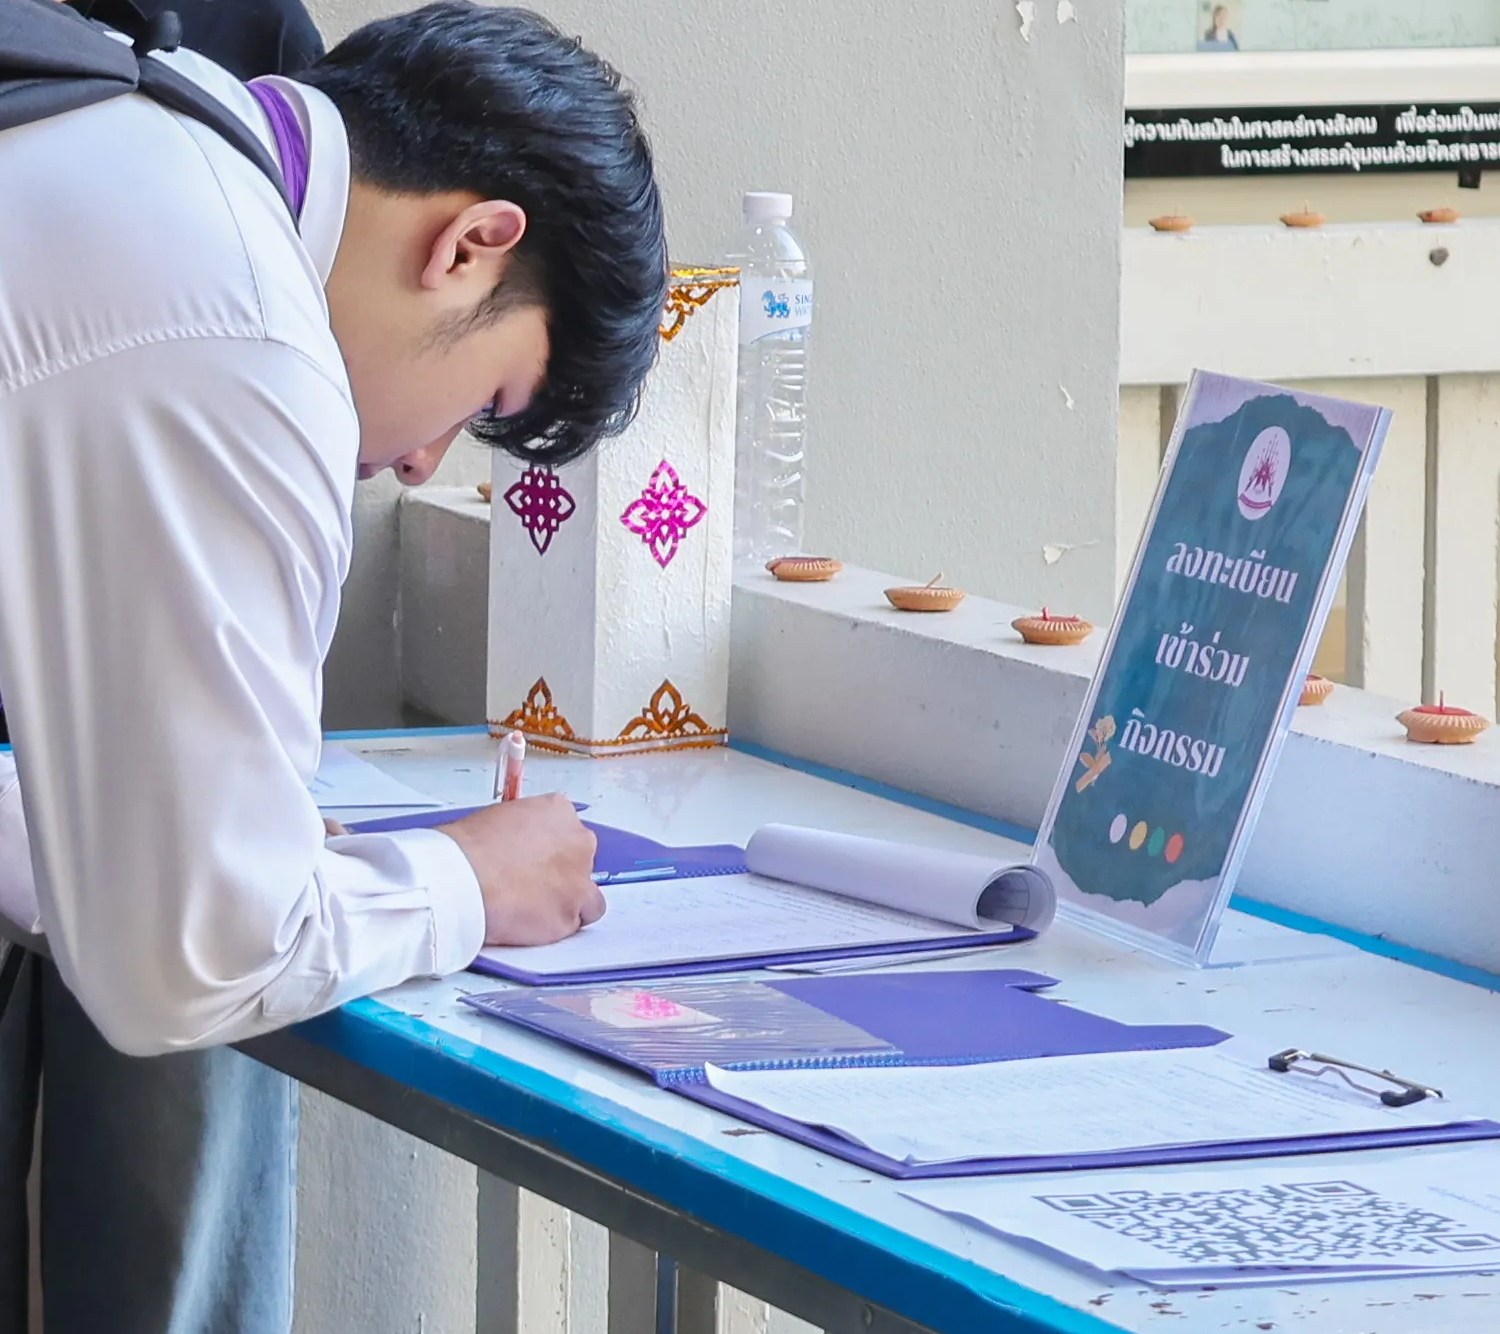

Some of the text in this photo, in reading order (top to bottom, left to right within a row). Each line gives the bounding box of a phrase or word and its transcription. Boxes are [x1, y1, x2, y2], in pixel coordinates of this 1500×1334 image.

[1165, 541, 1298, 605] ลงทะเบียน
[1155, 621, 1249, 688] เข้าร่วม
[1118, 708, 1227, 779] กิจกรรม
